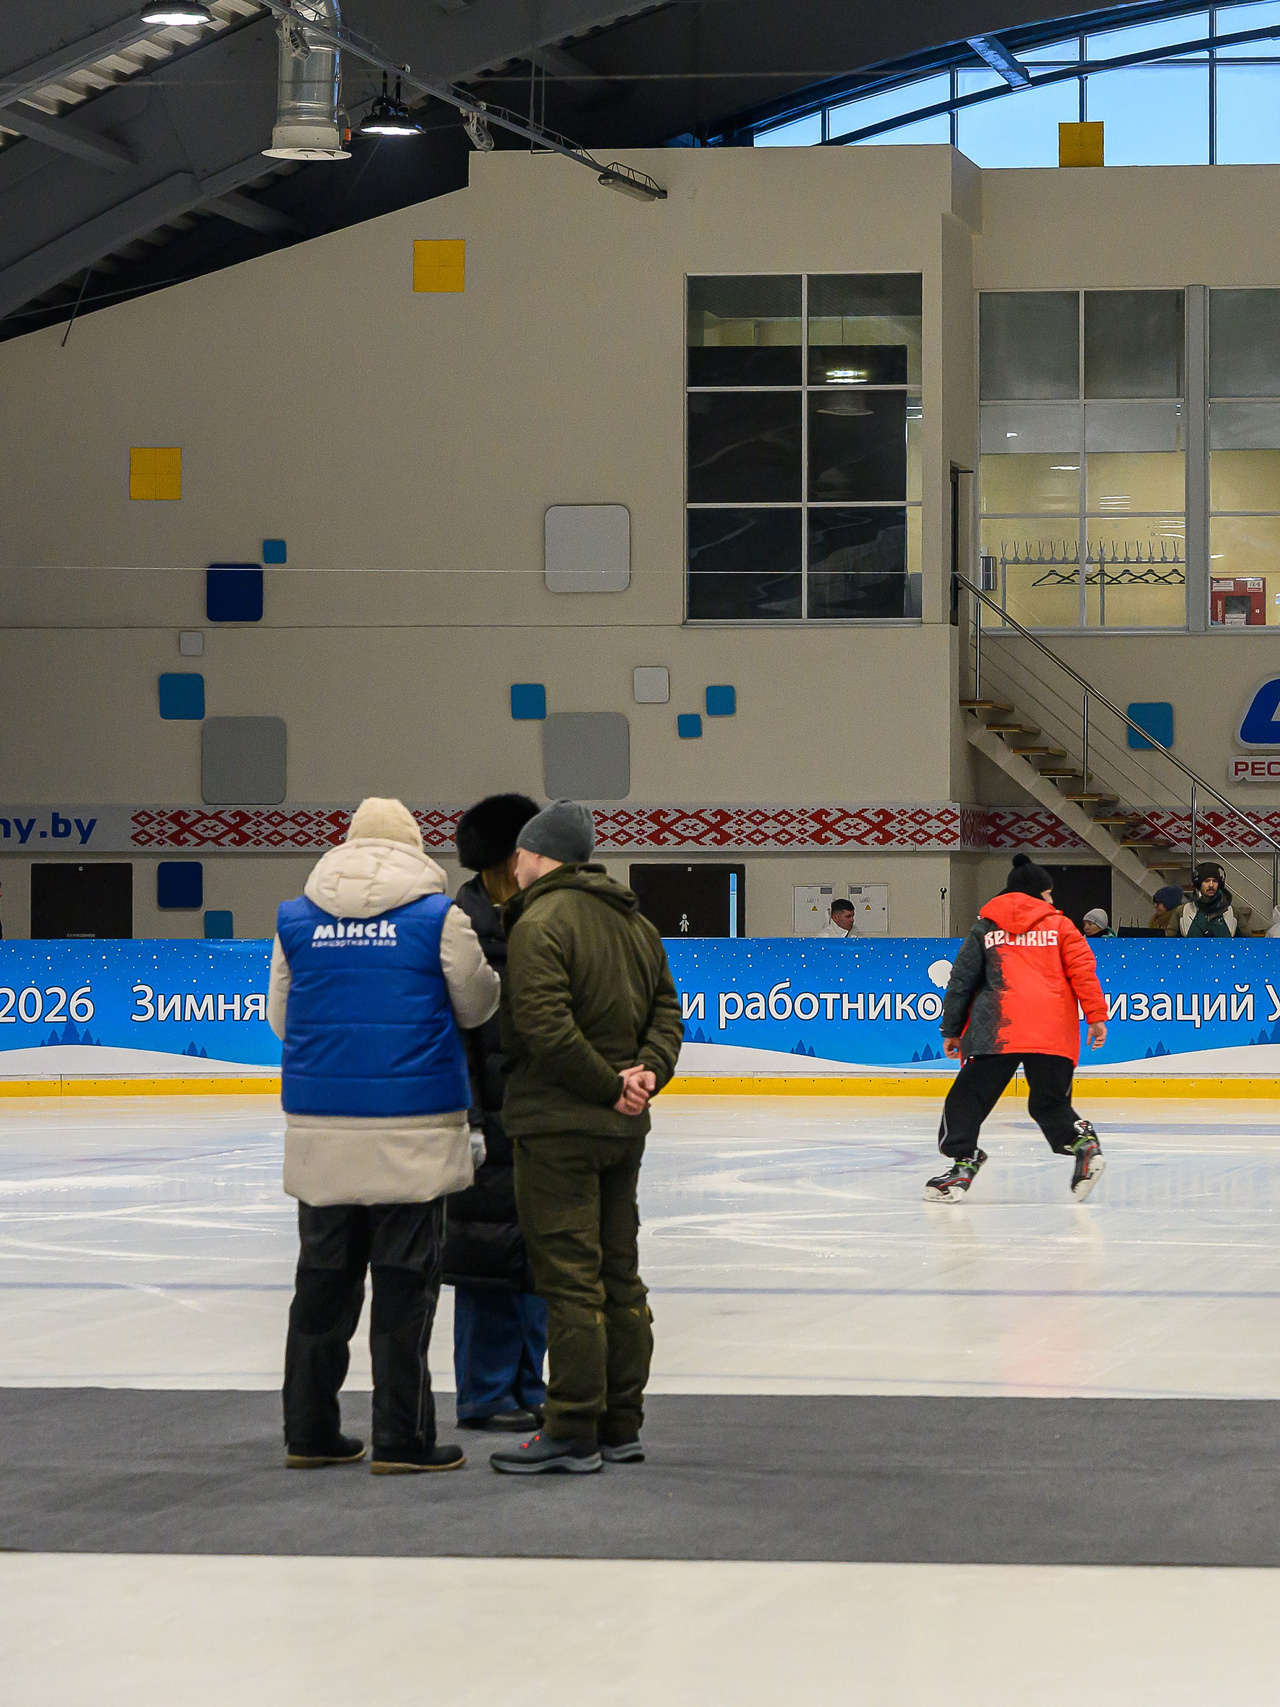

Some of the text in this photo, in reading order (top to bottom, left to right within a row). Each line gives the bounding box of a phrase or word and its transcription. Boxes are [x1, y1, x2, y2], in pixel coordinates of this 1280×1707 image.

[983, 930, 1058, 949] BELARUS
[0, 986, 95, 1023] 2026
[130, 984, 267, 1022] Зимня
[718, 981, 944, 1030] работнико
